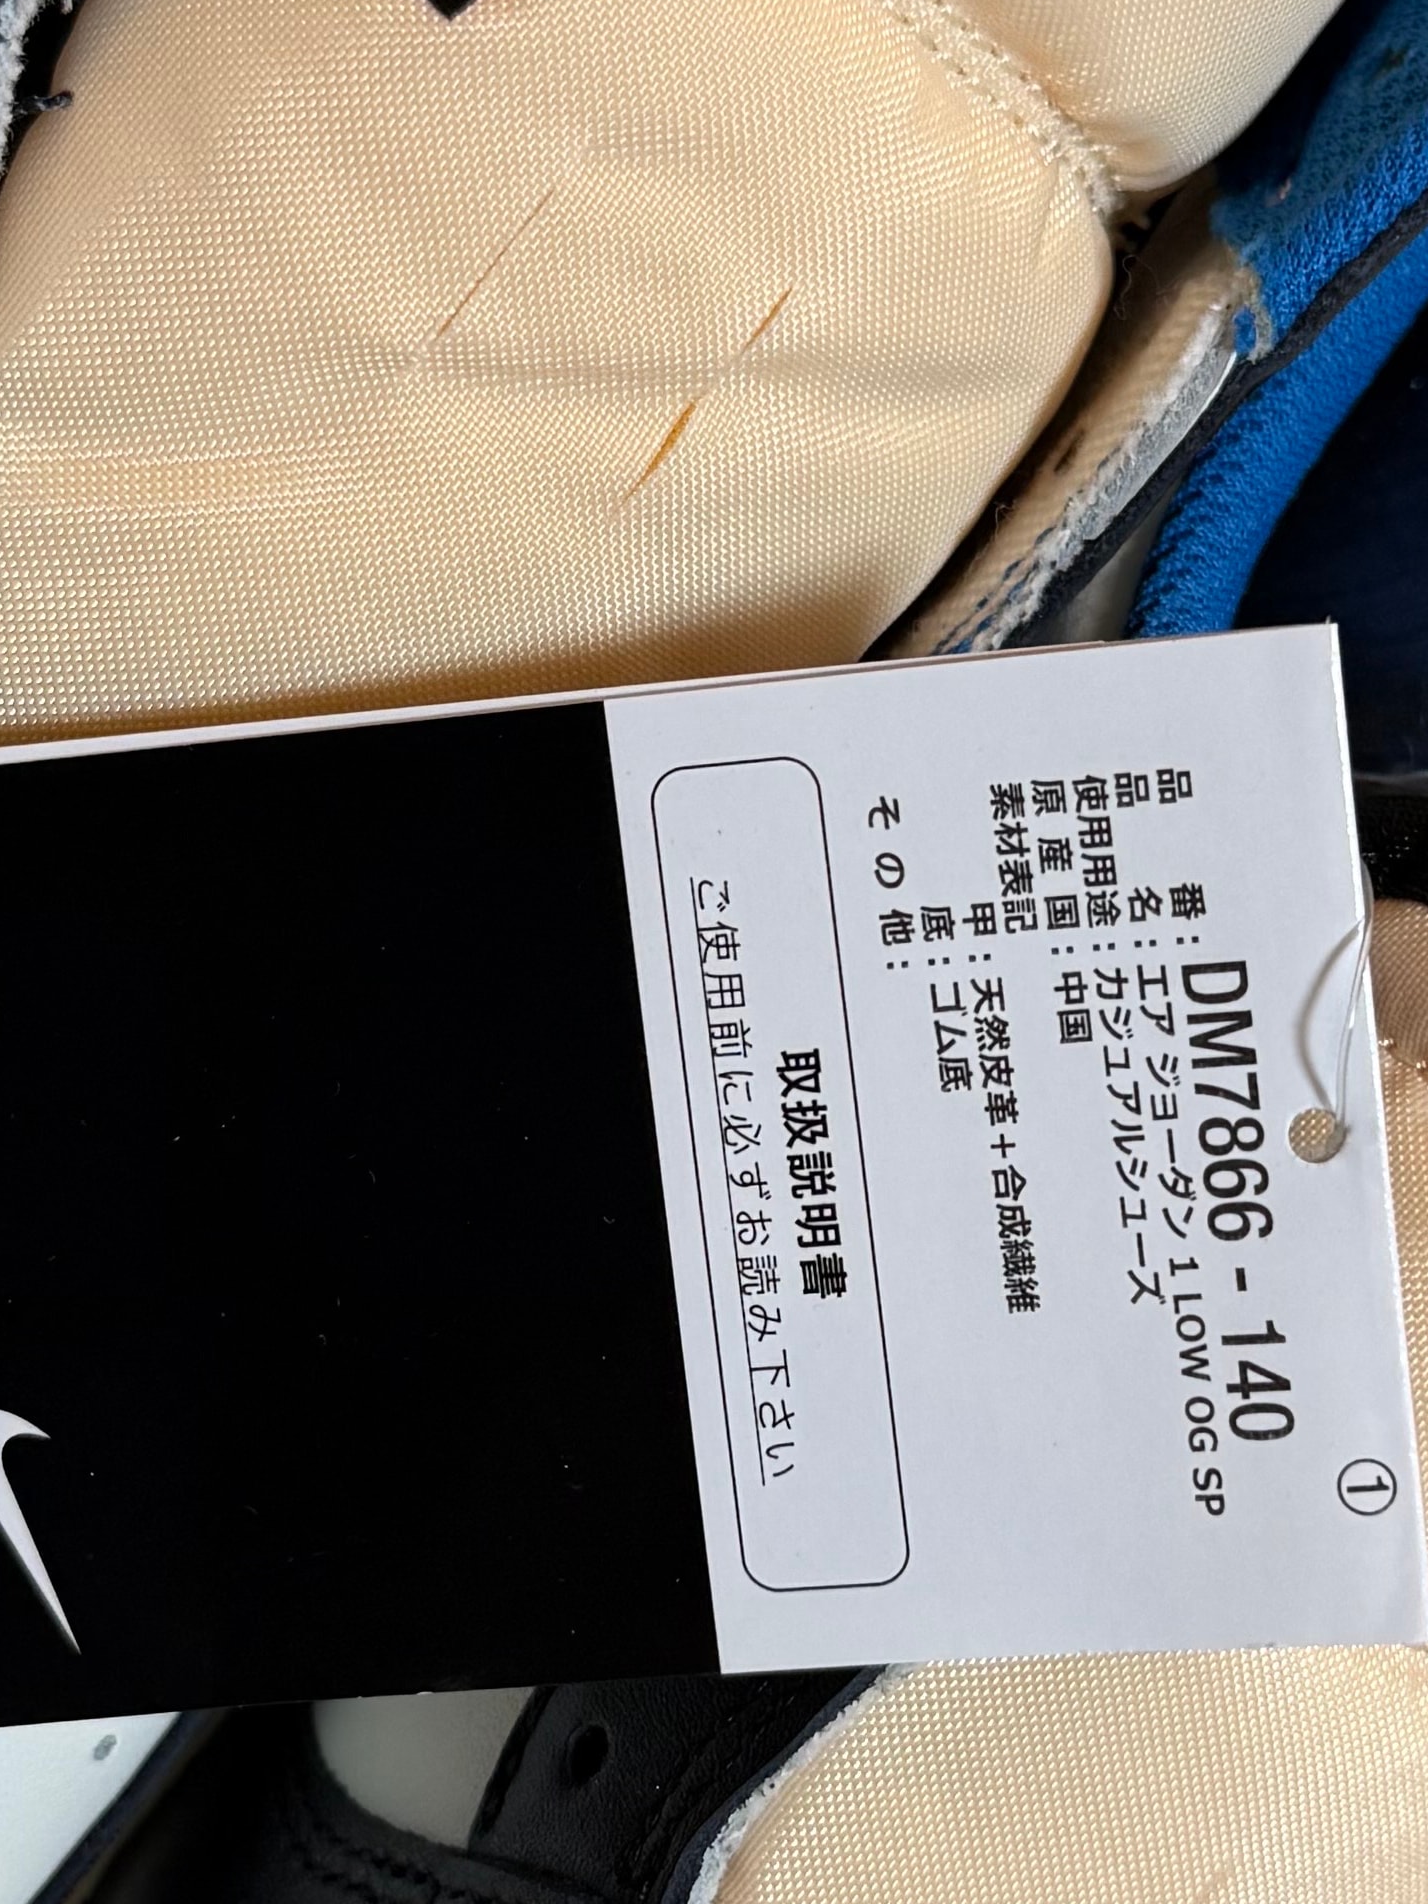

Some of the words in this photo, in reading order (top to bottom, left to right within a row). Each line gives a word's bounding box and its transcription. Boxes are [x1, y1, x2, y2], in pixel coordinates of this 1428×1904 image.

[988, 782, 1039, 934] 素材表記
[1180, 960, 1274, 1242] DM7866
[697, 879, 794, 1479] ご使用前に必ずお読み下さい
[775, 1047, 847, 1300] 取扱説明書
[1171, 1293, 1211, 1382] LOW
[1220, 1319, 1295, 1441] 140
[1184, 1396, 1218, 1453] OG
[1191, 1467, 1225, 1516] SP
